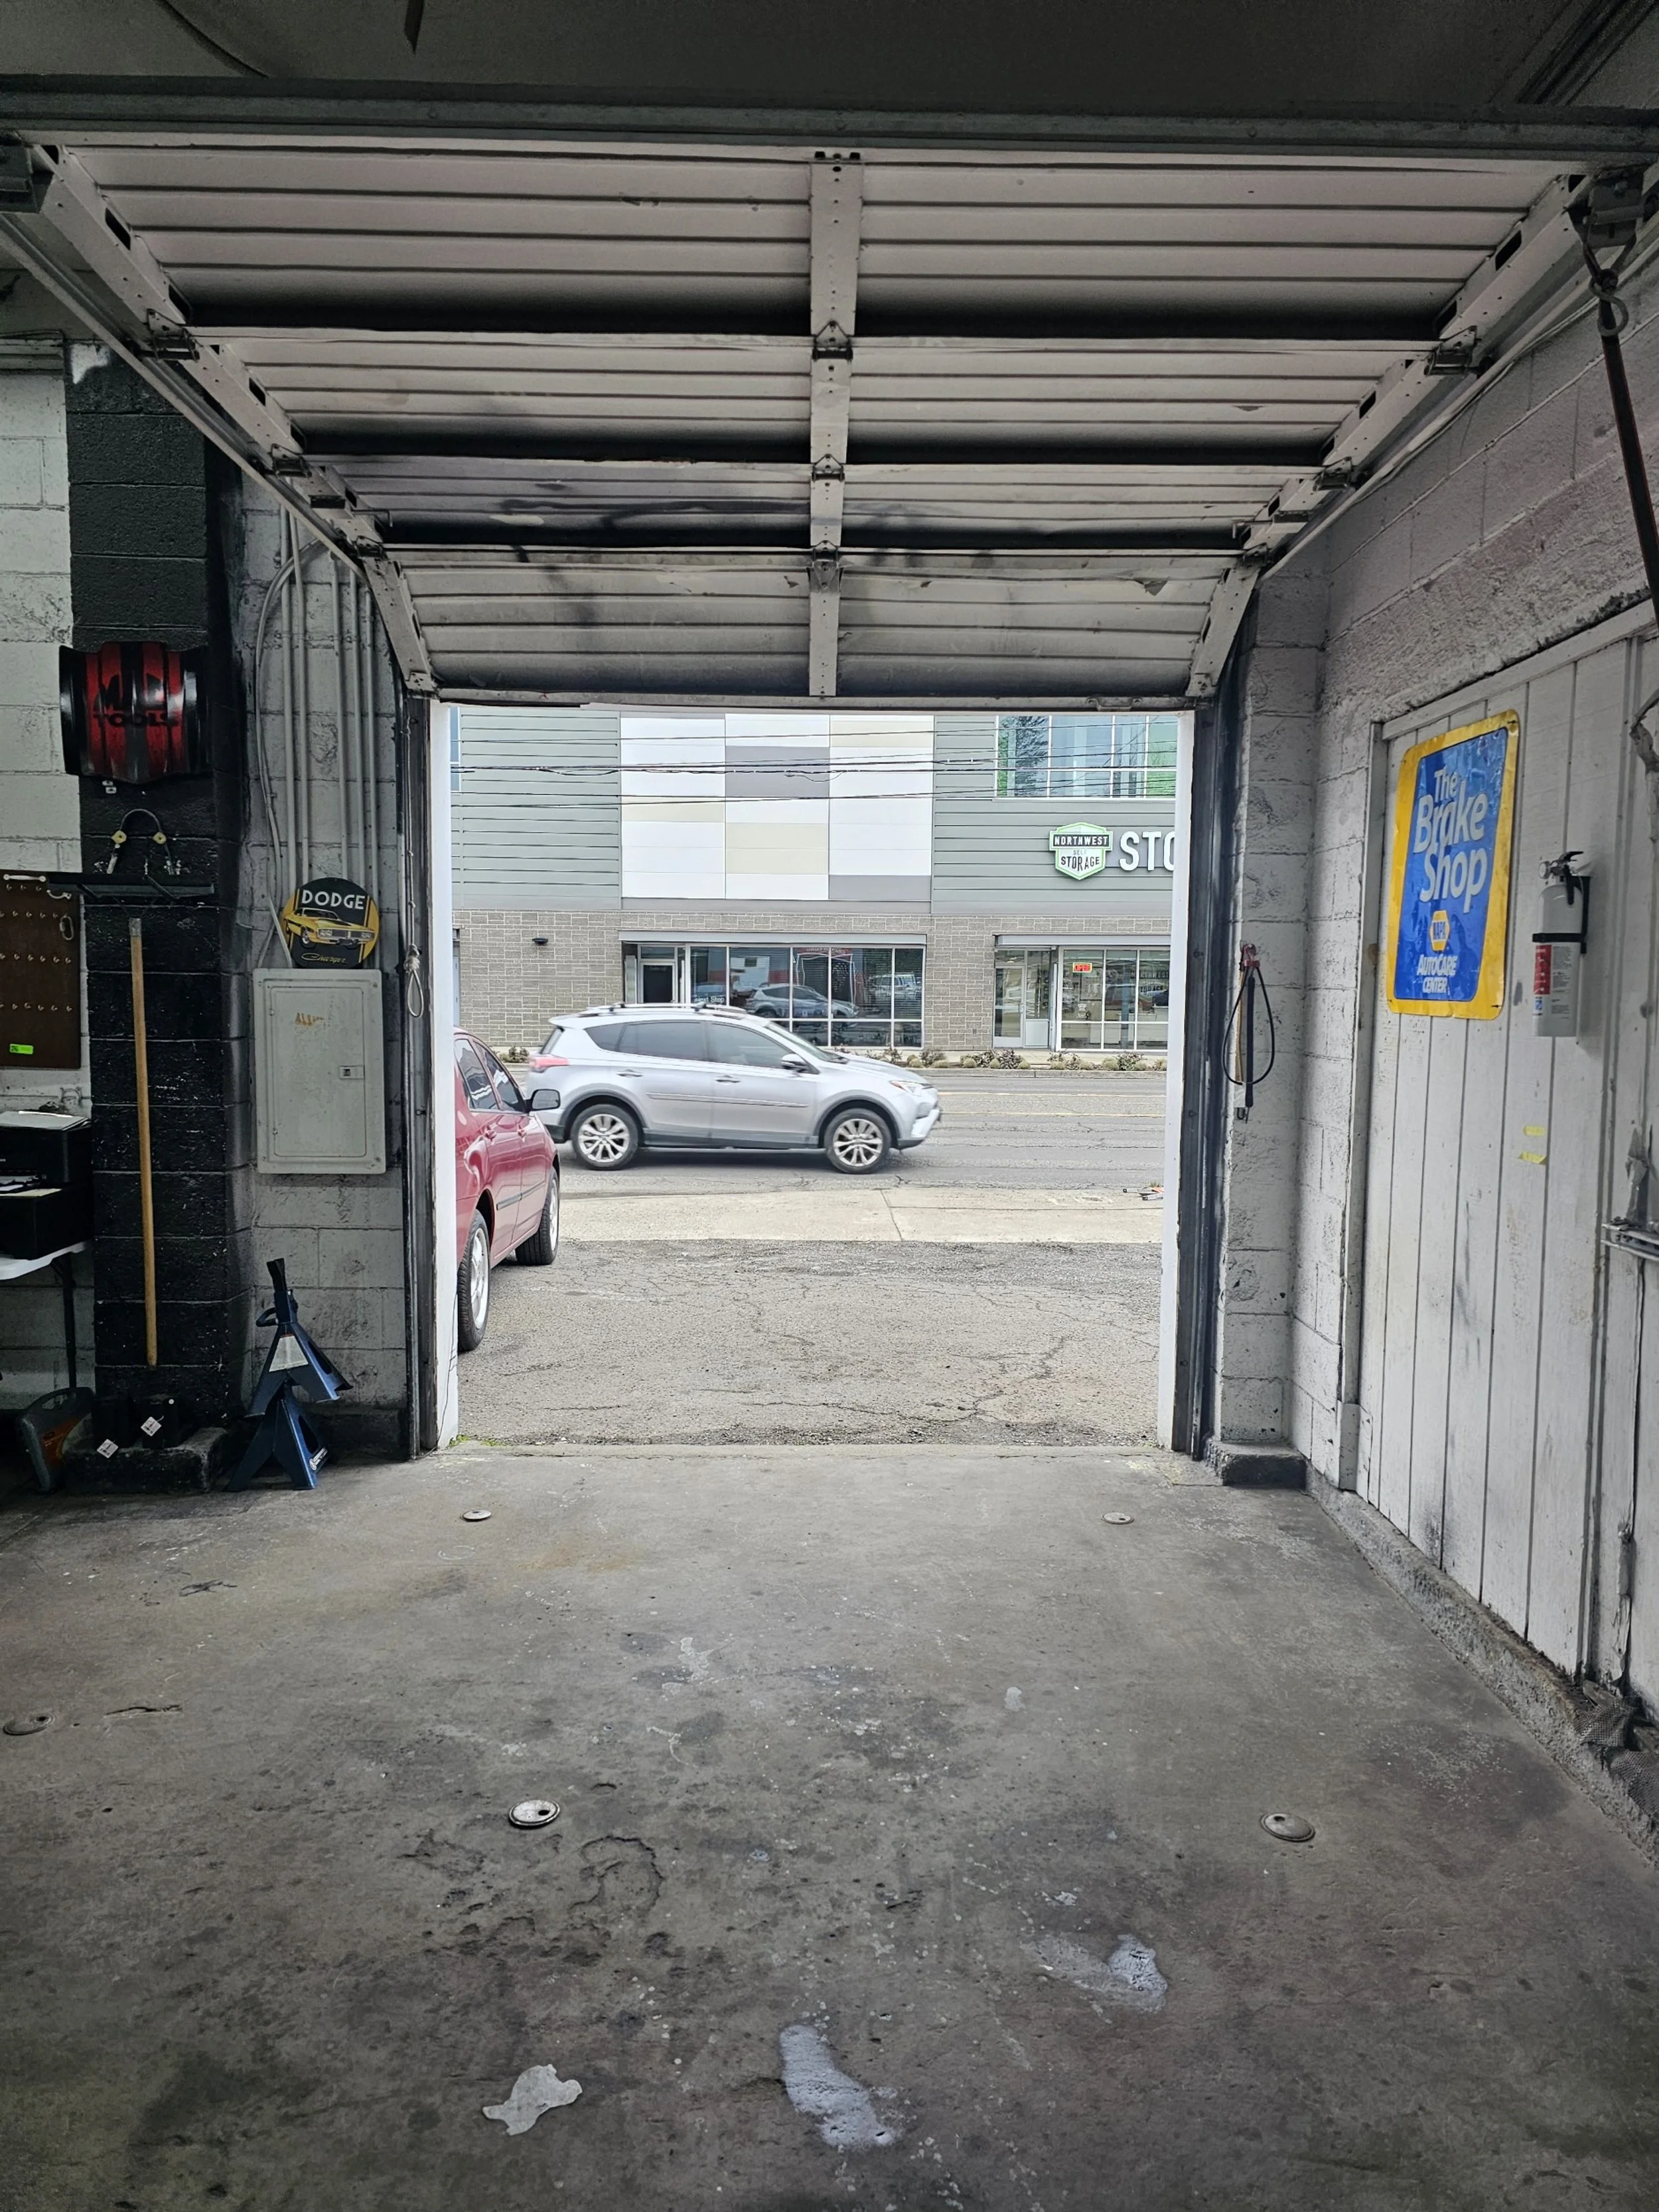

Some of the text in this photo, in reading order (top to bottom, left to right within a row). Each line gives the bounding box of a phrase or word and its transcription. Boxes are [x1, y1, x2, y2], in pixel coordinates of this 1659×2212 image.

[1434, 766, 1458, 802] The
[1413, 780, 1488, 853] Brake
[1054, 835, 1109, 847] NORTHWEST
[1060, 856, 1100, 872] STORAGE
[1419, 842, 1488, 914] Shop
[301, 889, 366, 910] DODGE
[301, 952, 347, 965] Charger
[1422, 976, 1448, 994] CENTER
